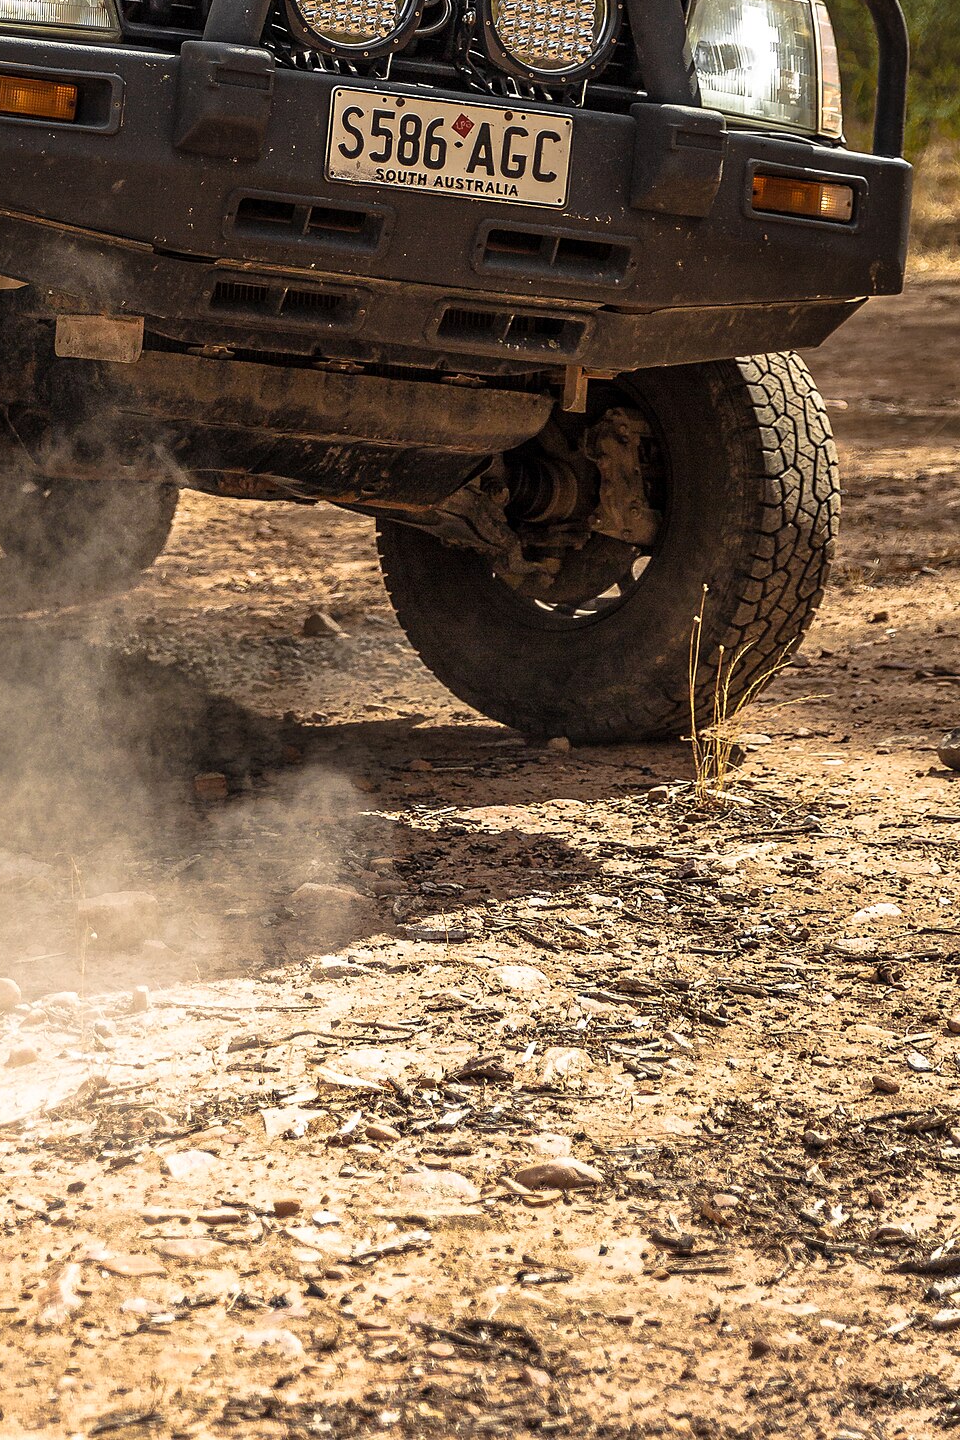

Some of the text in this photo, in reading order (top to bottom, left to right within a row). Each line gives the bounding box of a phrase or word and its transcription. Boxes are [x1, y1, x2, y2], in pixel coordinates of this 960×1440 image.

[337, 105, 562, 183] S586 AGC
[375, 168, 519, 197] SOUTH AUSTRALIA
